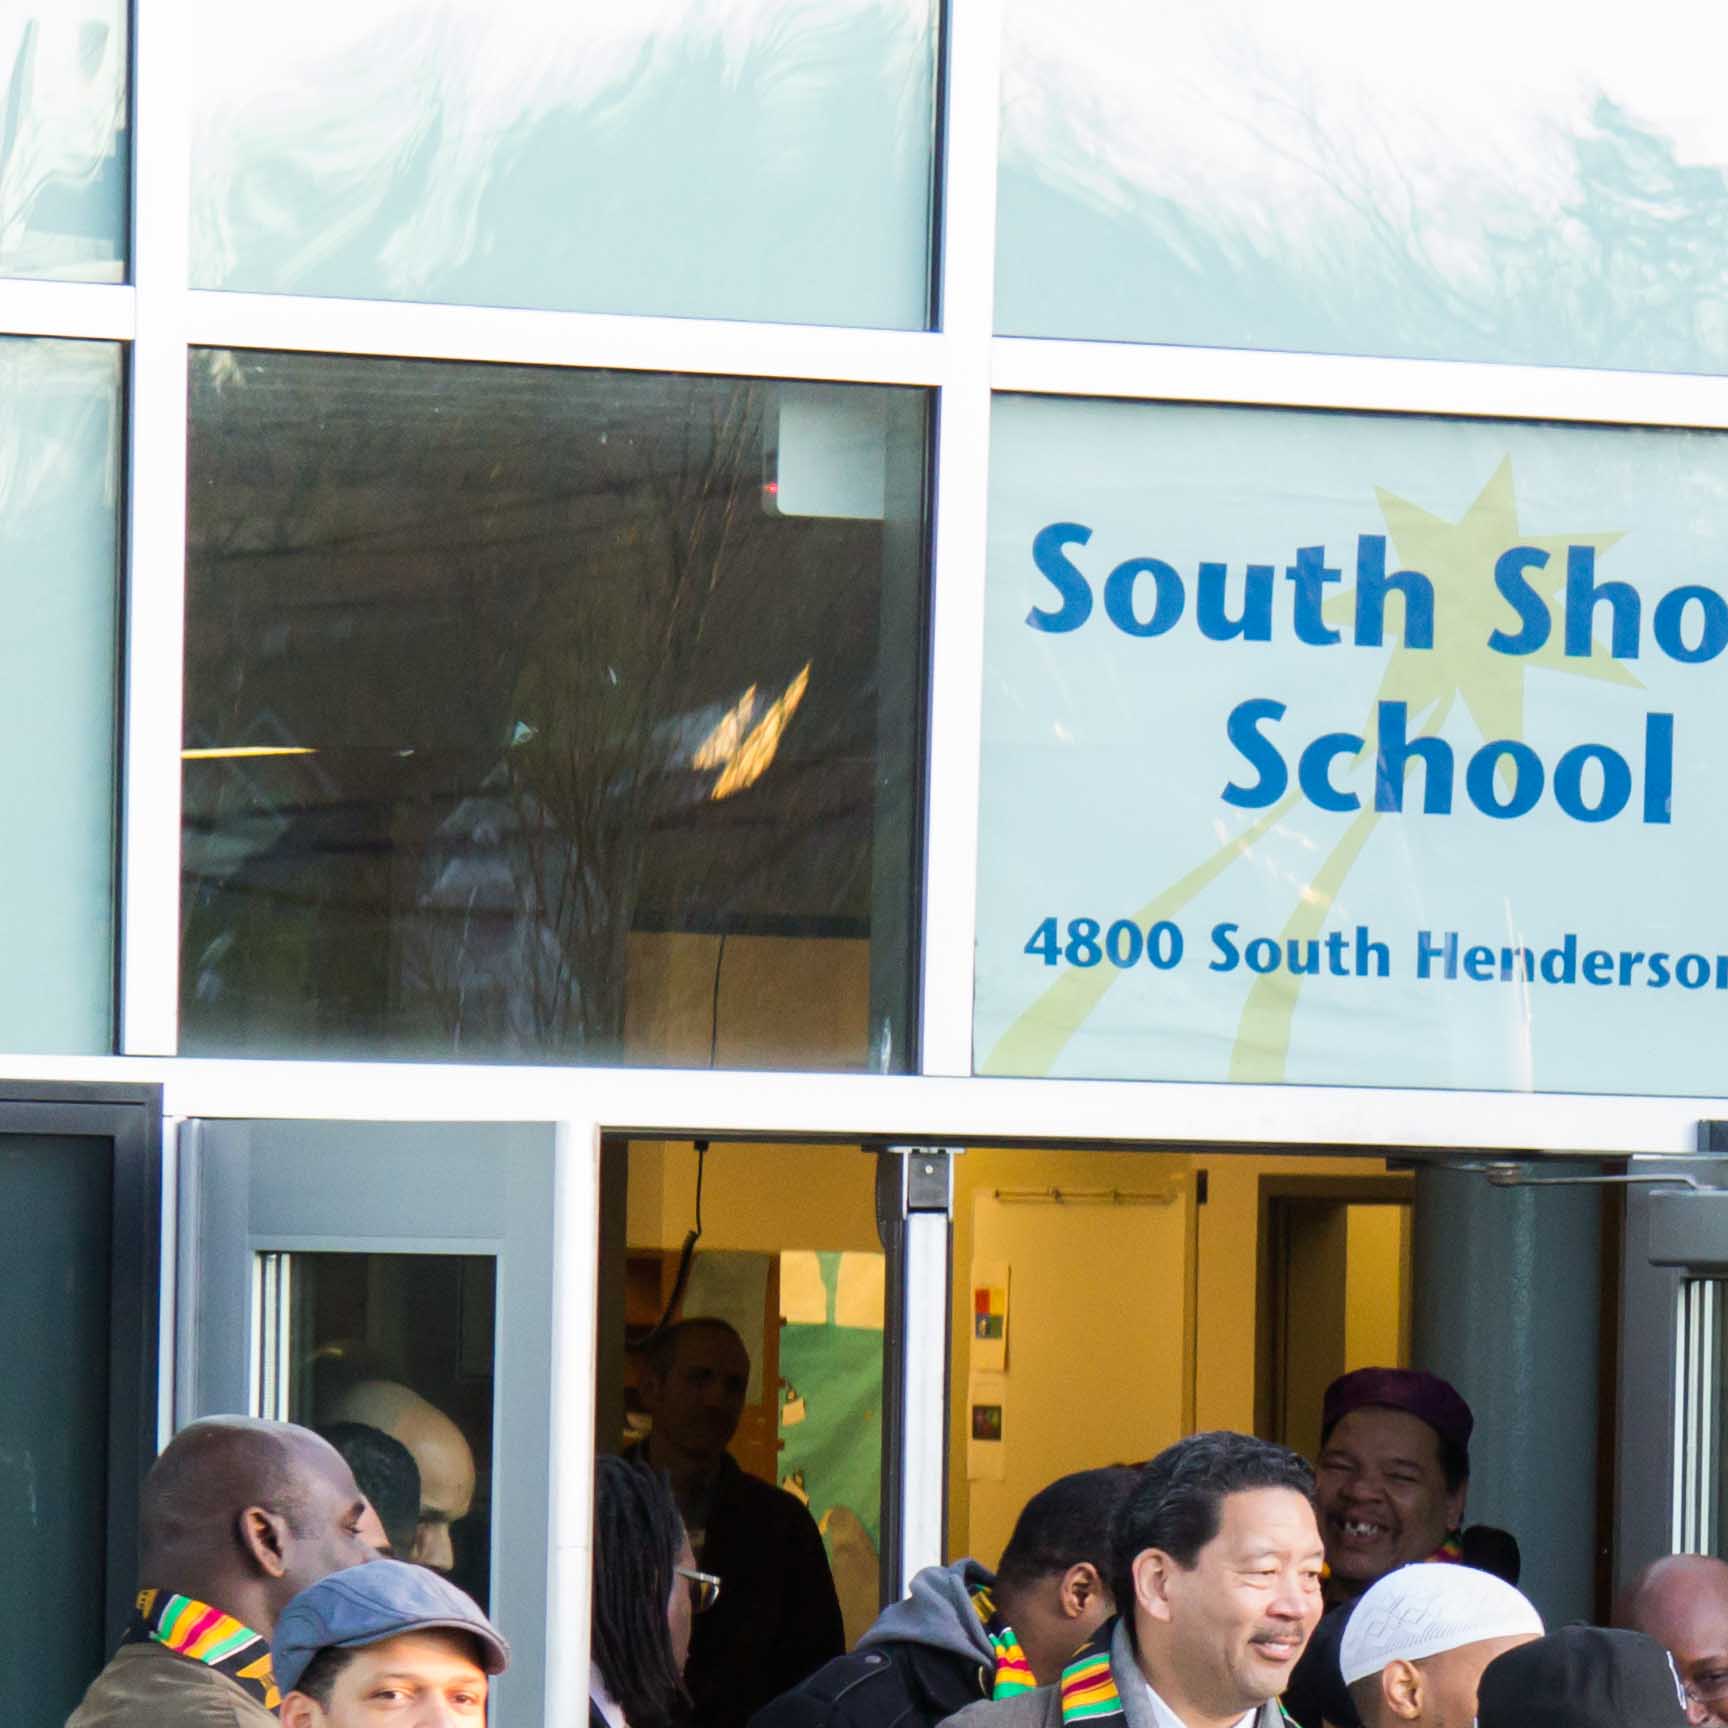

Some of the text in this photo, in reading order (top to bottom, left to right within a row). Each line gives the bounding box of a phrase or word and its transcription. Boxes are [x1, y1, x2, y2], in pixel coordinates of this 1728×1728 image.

[1025, 522, 1435, 648] South
[1221, 698, 1674, 824] School
[1025, 917, 1184, 969] 4800
[1209, 923, 1390, 977] South
